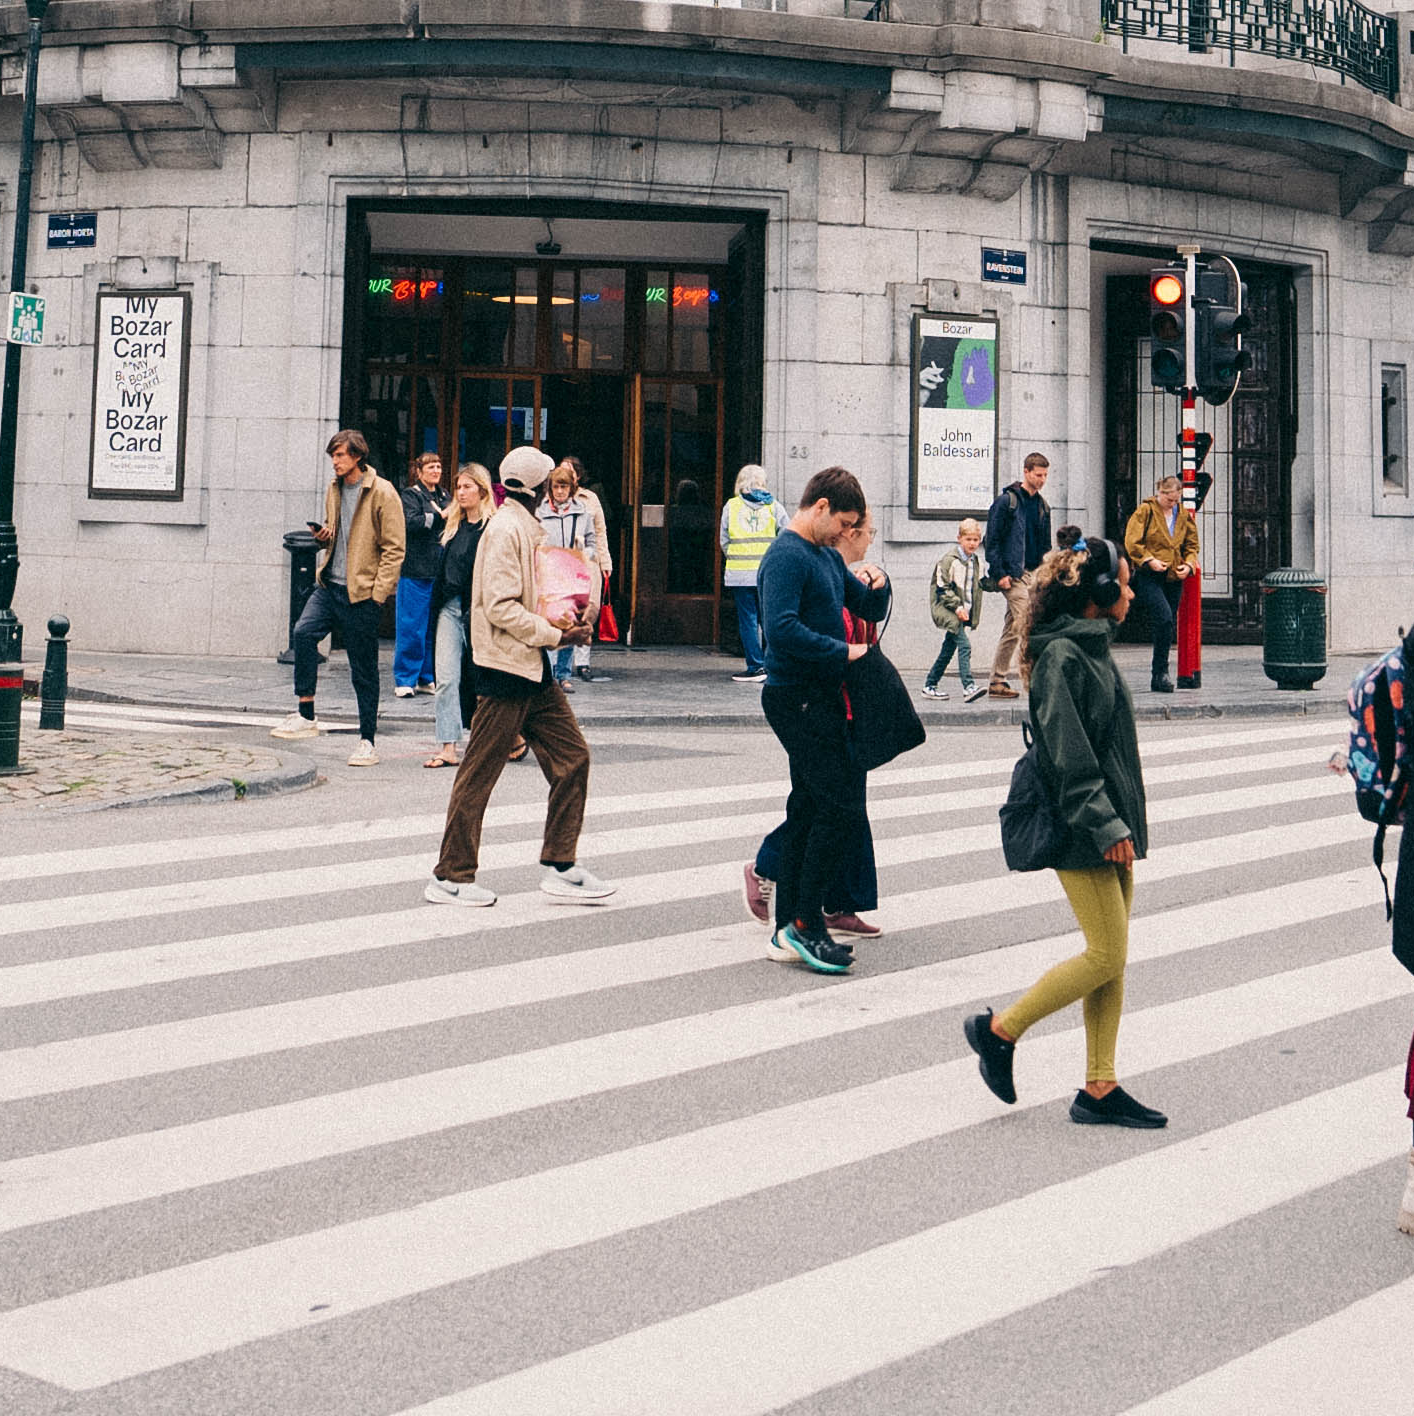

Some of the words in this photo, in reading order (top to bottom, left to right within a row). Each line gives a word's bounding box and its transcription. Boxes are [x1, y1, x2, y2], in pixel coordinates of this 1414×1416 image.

[126, 296, 158, 319] My
[111, 316, 172, 336] Bozar
[942, 321, 973, 335] Bozar
[114, 338, 166, 358] Card
[122, 389, 154, 413] My
[106, 409, 168, 431] Bozar
[109, 431, 162, 452] Card
[941, 428, 972, 442] John
[923, 443, 990, 458] Baldessari
